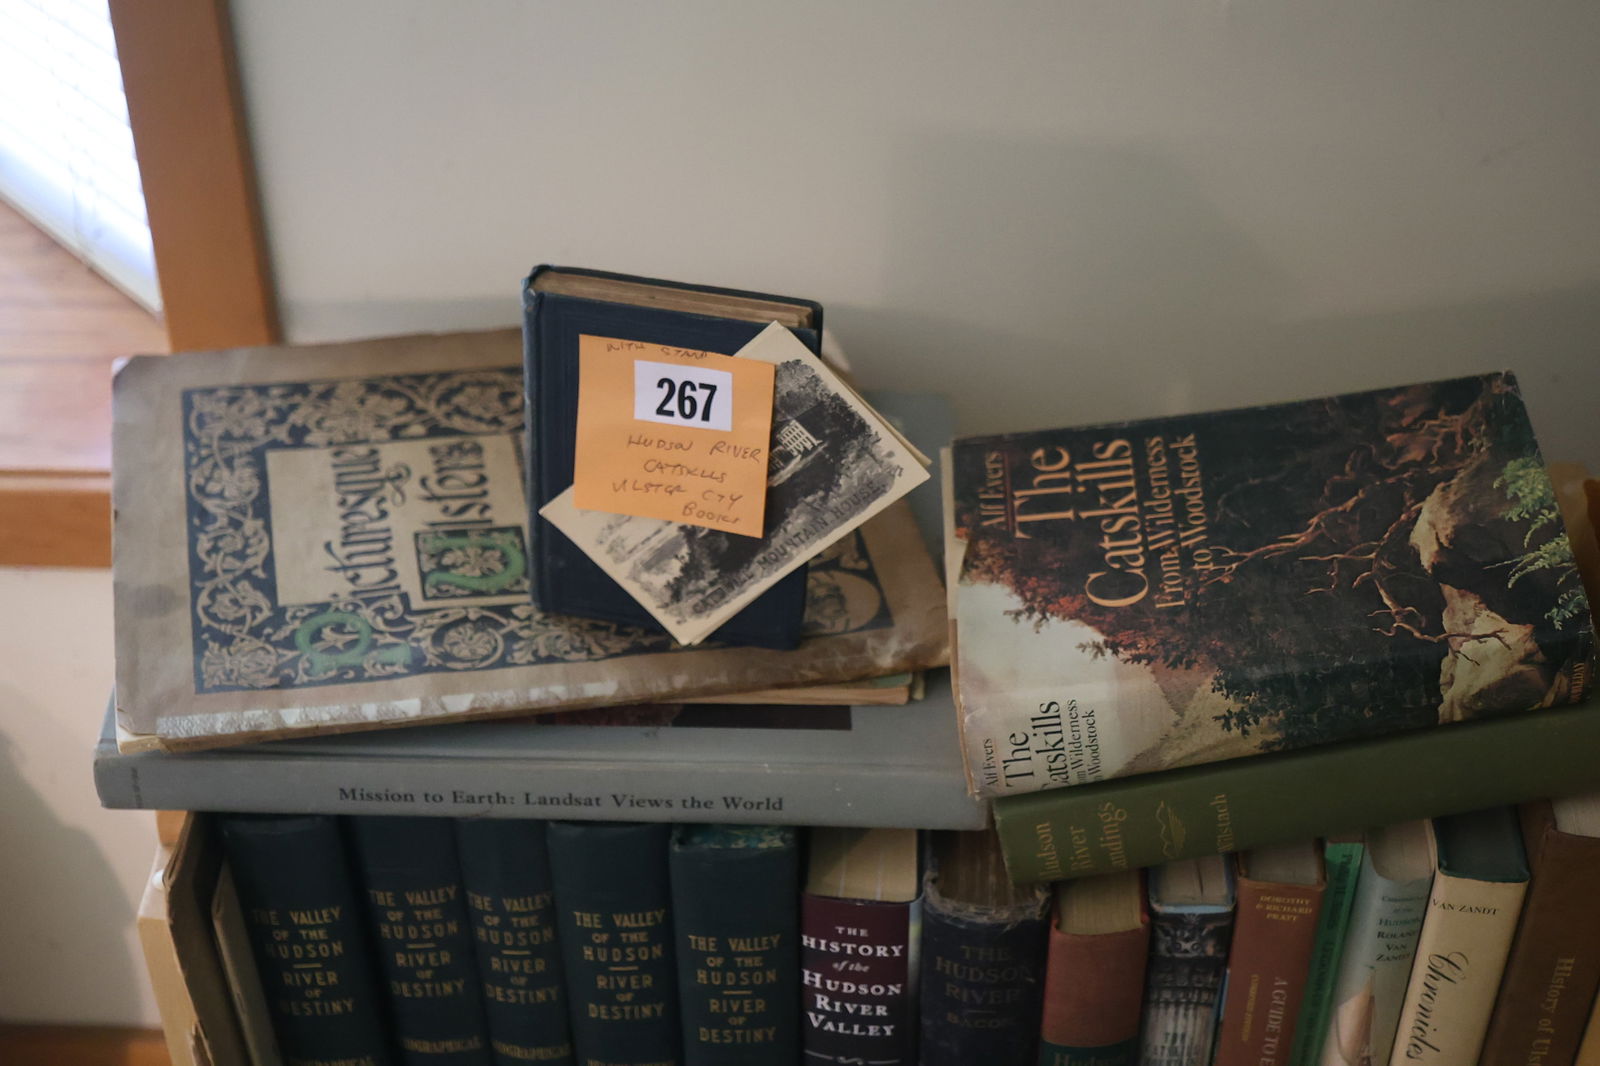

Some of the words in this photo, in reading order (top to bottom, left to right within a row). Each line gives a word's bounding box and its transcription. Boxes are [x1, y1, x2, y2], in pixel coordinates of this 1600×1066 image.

[656, 377, 718, 422] 267
[626, 434, 694, 451] HUDSON
[709, 440, 761, 463] RIVER
[978, 451, 1005, 498] Evers
[1014, 446, 1075, 539] The
[1143, 435, 1176, 551] Wilderness
[1169, 433, 1208, 547] Woodstock
[1073, 439, 1149, 608] Catskills
[756, 517, 830, 572] MOUNTAIN
[1191, 547, 1214, 571] to
[1156, 546, 1185, 608] From
[1066, 699, 1084, 771] Wilderness
[1081, 709, 1102, 777] Woodstock
[982, 738, 997, 768] Evers
[1002, 731, 1035, 787] The
[338, 787, 416, 803] Mission
[423, 791, 445, 804] to
[452, 790, 516, 806] Earth:
[523, 792, 602, 807] Landsat
[611, 793, 674, 809] Views
[681, 796, 714, 810] the
[721, 796, 785, 811] World
[368, 888, 396, 907] THE
[404, 884, 459, 906] VALLEY
[466, 889, 494, 912] THE
[502, 891, 552, 913] VALLEY
[289, 905, 342, 926] VALLEY
[386, 910, 405, 922] OF
[413, 908, 443, 921] THE
[1432, 898, 1458, 912] VAN
[1459, 903, 1500, 917] ZANDT
[482, 914, 500, 927] OF
[511, 914, 540, 929] THE
[572, 910, 603, 929] THE
[612, 908, 666, 929] VALLEY
[272, 929, 290, 941] OF
[299, 928, 329, 941] THE
[380, 921, 460, 942] HUDSON
[476, 925, 555, 947] HUDSON
[591, 931, 610, 944] OF
[620, 930, 650, 944] THE
[834, 925, 869, 938] THE
[582, 942, 664, 963] HUDSON
[687, 933, 718, 953] THE
[727, 932, 782, 952] VALLEY
[801, 934, 905, 959] HISTORY
[394, 949, 452, 968] RIVER
[490, 957, 547, 975] RIVER
[706, 955, 725, 968] OF
[733, 956, 764, 968] THE
[831, 959, 849, 973] of
[848, 960, 870, 974] the
[281, 971, 339, 986] RIVER
[415, 969, 433, 980] OF
[510, 975, 528, 987] OF
[596, 973, 654, 991] RIVER
[695, 968, 778, 987] HUDSON
[801, 967, 903, 997] HUDSON
[1273, 976, 1289, 987] A
[1540, 956, 1576, 1014] History
[304, 988, 321, 999] OF
[390, 979, 466, 999] DESTINY
[484, 985, 559, 1006] DESTINY
[615, 992, 635, 1003] OF
[587, 1002, 666, 1021] DESTINY
[708, 997, 767, 1014] RIVER
[813, 993, 889, 1017] RIVER
[1265, 988, 1288, 1033] GUIDE
[1406, 951, 1470, 1061] Chronicles
[727, 1015, 748, 1027] OF
[806, 1011, 896, 1038] VALLEY
[1538, 1018, 1556, 1033] of
[698, 1025, 777, 1045] DESTINY
[1262, 1036, 1280, 1056] TO
